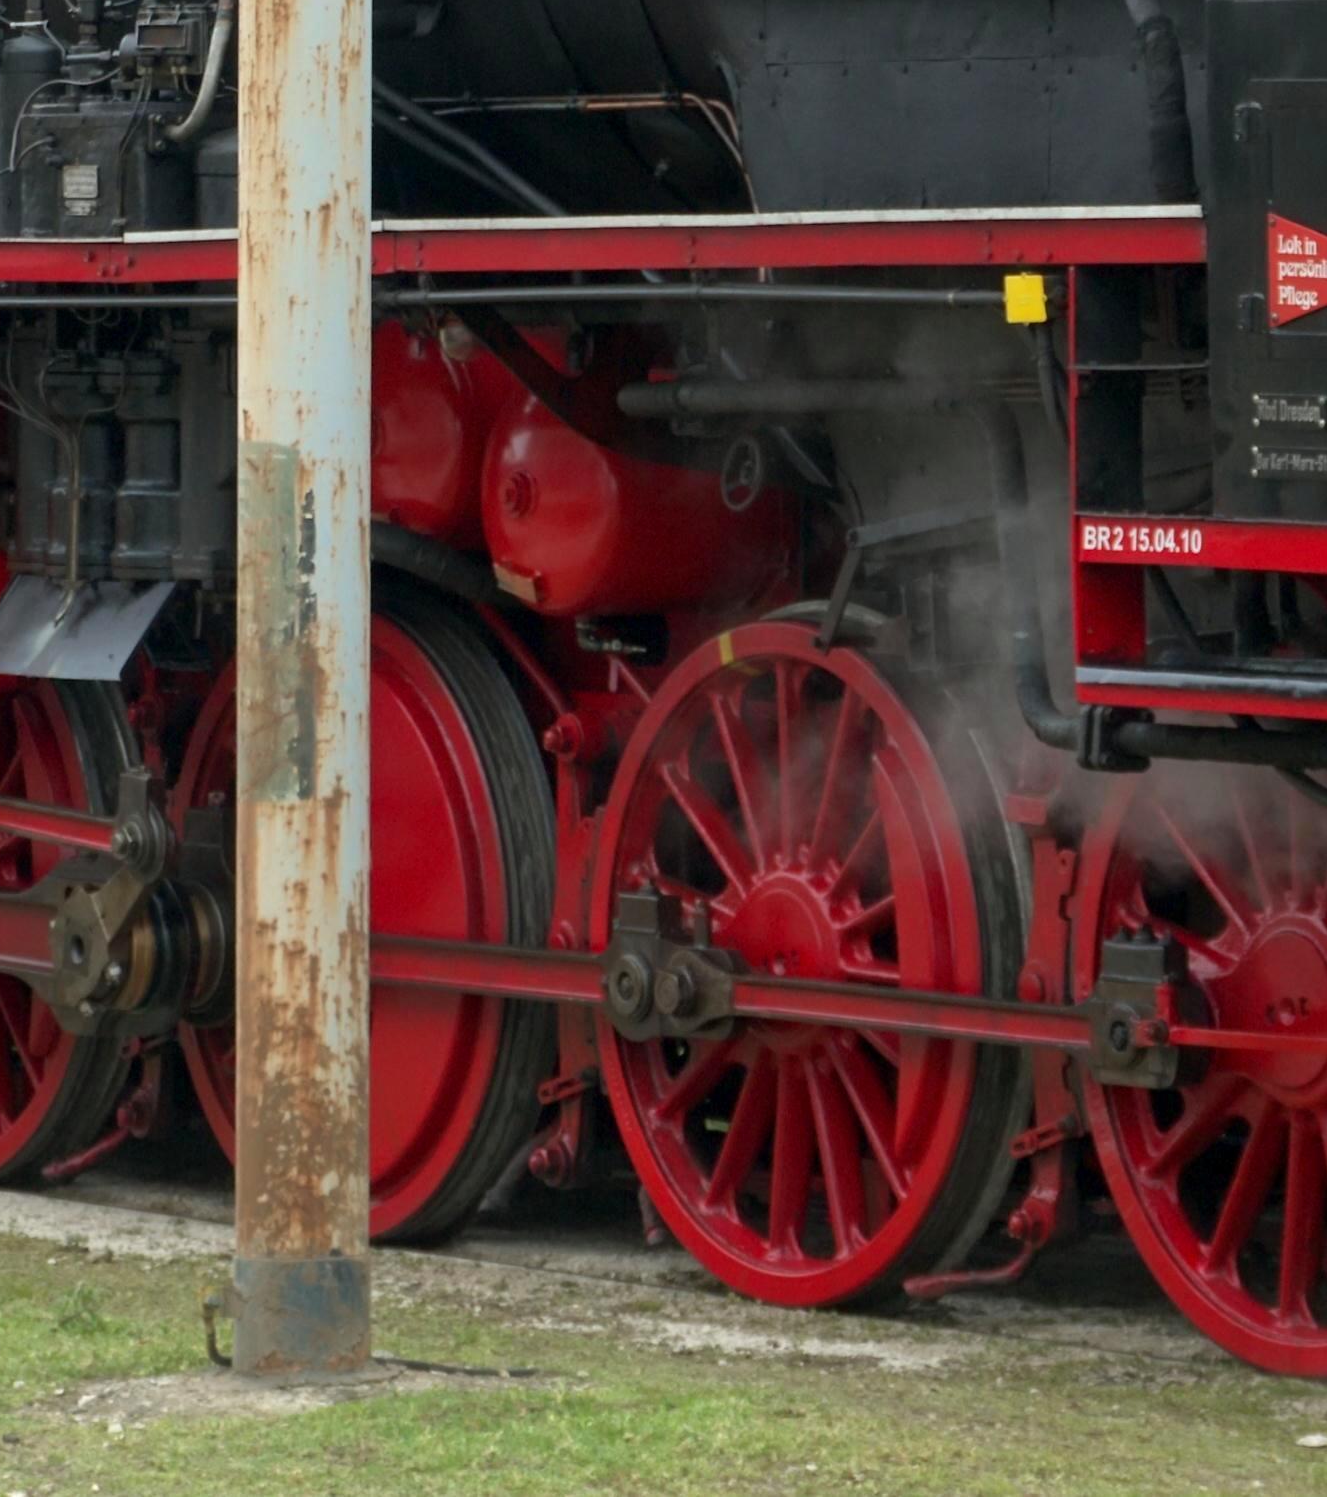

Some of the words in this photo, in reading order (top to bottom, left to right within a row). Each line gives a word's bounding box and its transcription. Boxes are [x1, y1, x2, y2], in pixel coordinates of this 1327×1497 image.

[1278, 234, 1303, 255] Lok
[1305, 237, 1317, 255] in
[1278, 285, 1318, 310] Pflege
[1128, 528, 1202, 554] 15.04.10
